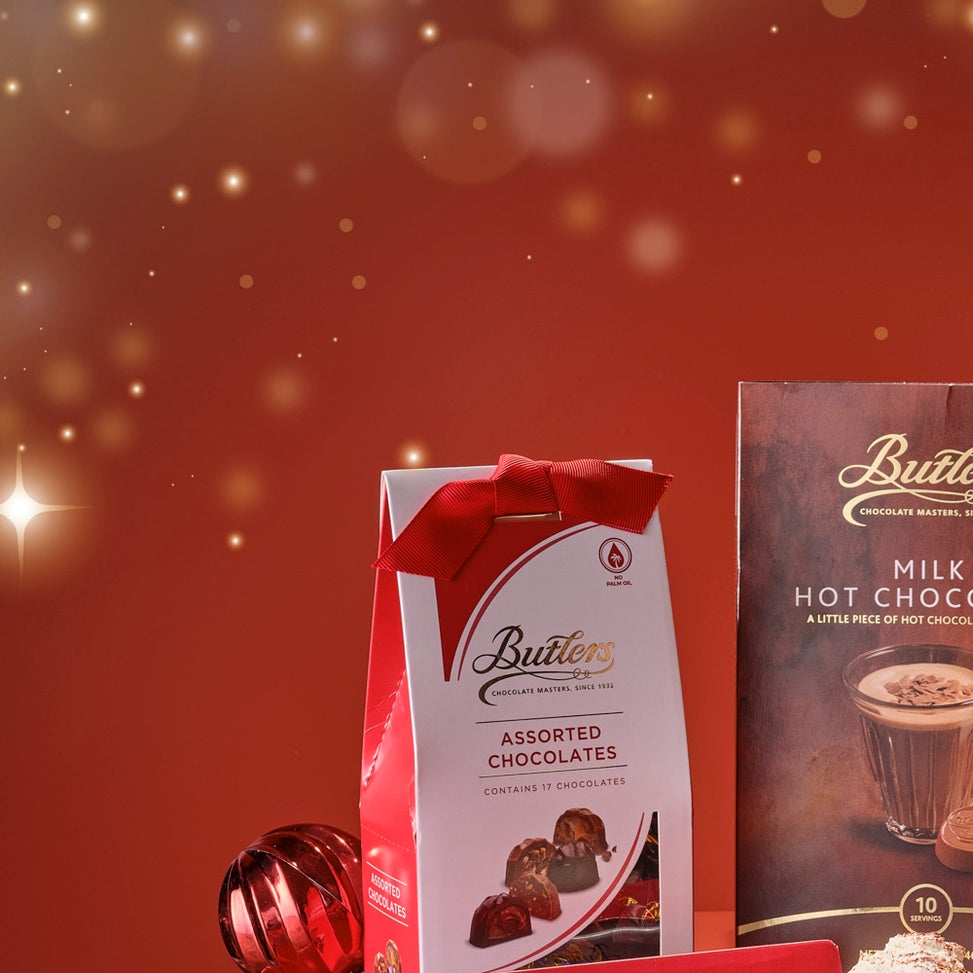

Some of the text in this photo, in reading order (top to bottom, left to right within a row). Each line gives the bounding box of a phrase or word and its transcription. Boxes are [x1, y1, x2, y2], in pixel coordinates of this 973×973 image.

[859, 507, 914, 516] CHOCOLATE
[917, 508, 962, 518] MASTERS,
[894, 559, 964, 580] MILK
[795, 586, 858, 607] HOT
[806, 614, 815, 623] A
[817, 614, 849, 624] LITTLE
[852, 614, 881, 625] PIECE
[883, 615, 898, 625] OF
[901, 615, 925, 625] HOT
[472, 624, 616, 681] Butlers
[491, 687, 534, 697] CHOCOLATE
[537, 685, 573, 693] MASTERS,
[501, 725, 601, 746] ASSORTED
[488, 746, 617, 768] CHOCOLATES
[484, 777, 626, 796] CONTAINS 17 CHOCOLATES
[371, 872, 401, 899] ASSORTED
[368, 887, 407, 919] CHOCOLATES
[915, 897, 938, 914] 10
[910, 915, 943, 923] SERVINGS
